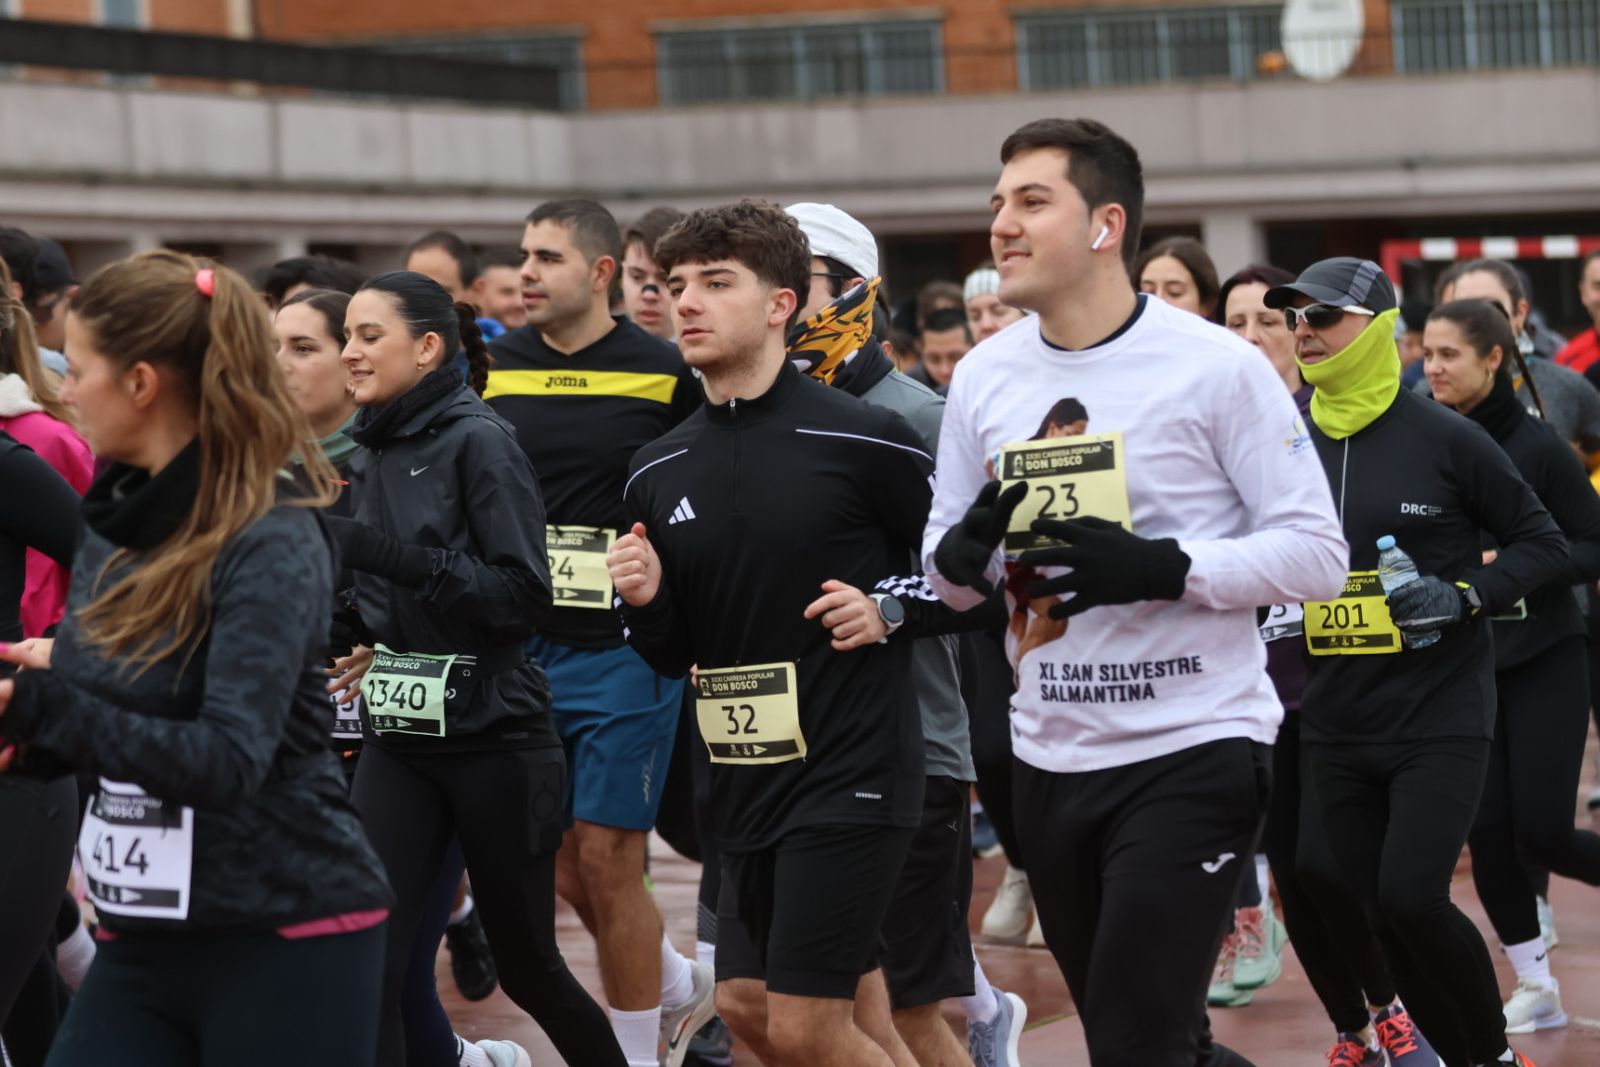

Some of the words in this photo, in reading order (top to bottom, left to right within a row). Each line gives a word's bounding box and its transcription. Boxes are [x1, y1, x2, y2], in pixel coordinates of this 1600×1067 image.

[1025, 459, 1049, 471] DON
[1050, 455, 1083, 468] BOSCO
[1036, 482, 1079, 519] 23
[1400, 502, 1428, 516] DRC
[1320, 603, 1369, 630] 201
[393, 661, 420, 670] BOSCO
[747, 671, 775, 680] POPULAR
[1039, 662, 1057, 681] XL
[1061, 663, 1093, 682] SAN
[1099, 655, 1203, 682] SILVESTRE
[712, 682, 729, 692] DON
[730, 680, 758, 690] BOSCO
[1040, 683, 1156, 703] SALMANTINA
[721, 704, 758, 735] 32
[93, 832, 149, 876] 414
